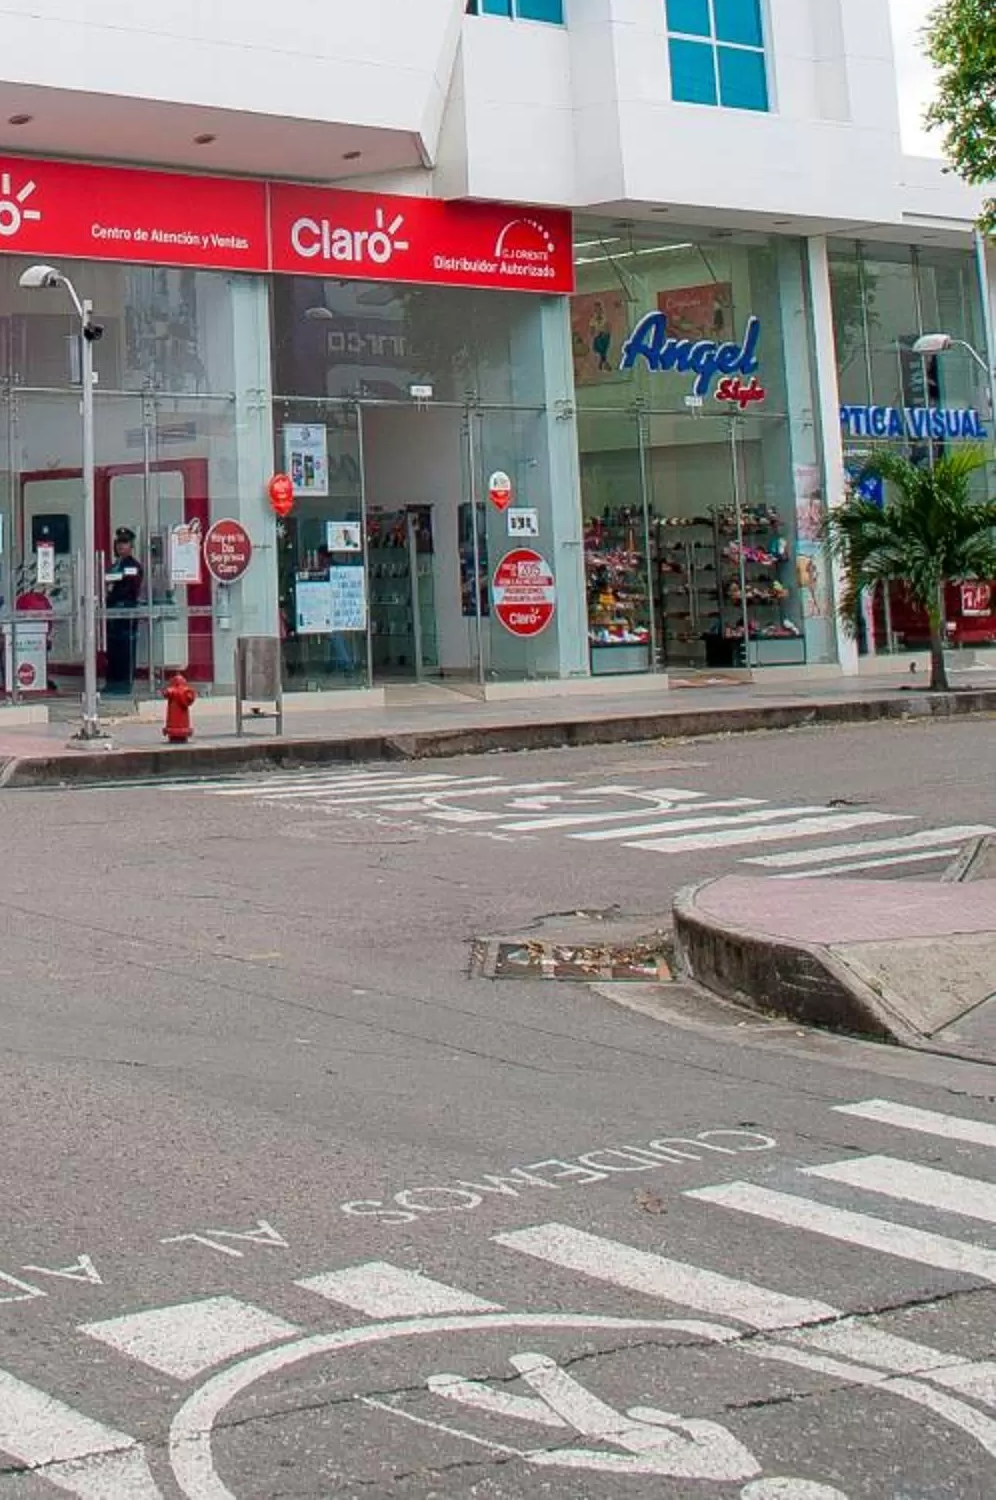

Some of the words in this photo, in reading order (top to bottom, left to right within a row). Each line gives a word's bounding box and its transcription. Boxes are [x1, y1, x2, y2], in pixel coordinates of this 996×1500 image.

[91, 223, 131, 241] Centro
[133, 227, 148, 241] de
[151, 228, 201, 245] Atención
[202, 235, 210, 249] y
[210, 233, 250, 249] Ventas
[291, 207, 409, 263] Claro
[433, 255, 498, 274] Distribuidor
[499, 260, 557, 278] Autorizado
[619, 311, 760, 396] Angel
[904, 406, 989, 439] VISUAL
[340, 1128, 778, 1226] CUIDEMOS
[159, 1219, 290, 1257] AL
